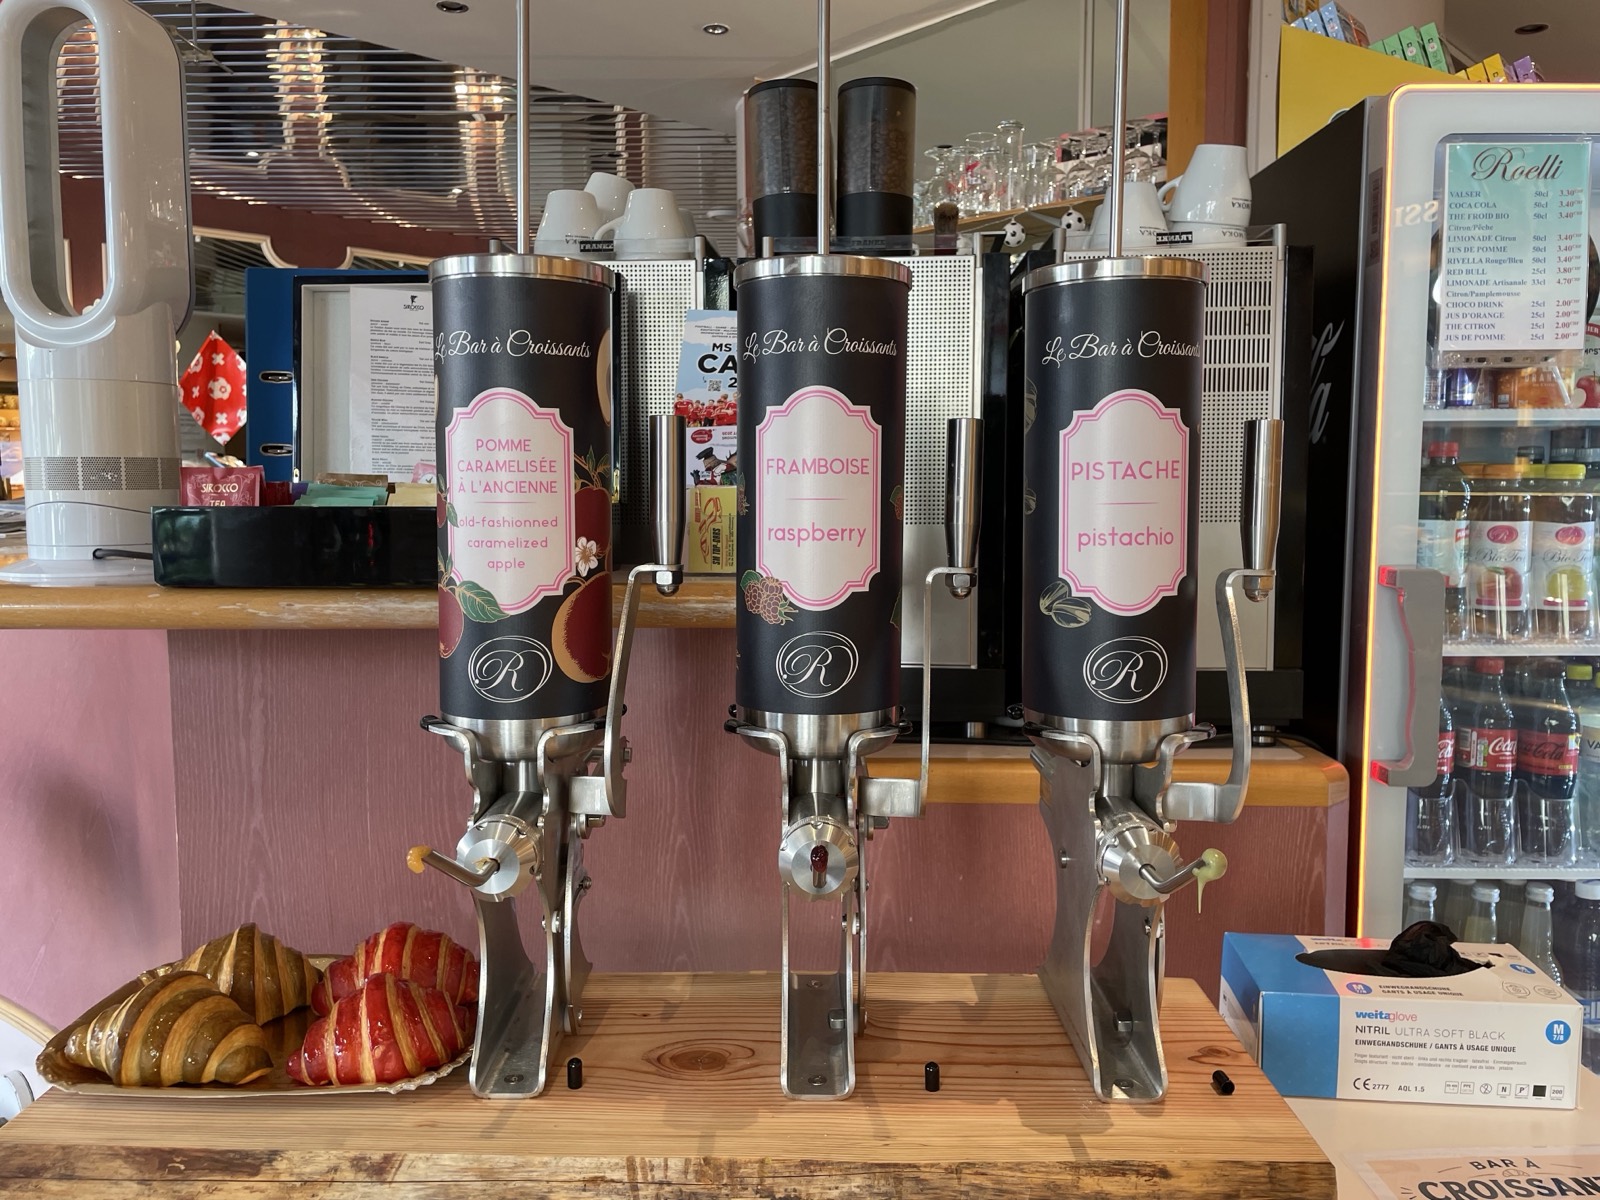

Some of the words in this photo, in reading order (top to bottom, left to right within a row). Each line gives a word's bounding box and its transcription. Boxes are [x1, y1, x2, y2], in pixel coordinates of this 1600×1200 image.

[1471, 147, 1564, 182] Roelli
[435, 332, 448, 364] Le
[448, 330, 488, 356] Bar
[491, 336, 502, 354] à
[507, 329, 591, 358] Croissants
[712, 343, 732, 352] MS
[743, 332, 760, 364] Le
[762, 329, 805, 355] Bar
[808, 335, 820, 352] à
[824, 327, 897, 356] Croissants
[1042, 336, 1066, 368] Le
[1069, 333, 1118, 359] Bar
[1121, 338, 1134, 356] à
[476, 438, 532, 452] POMME
[458, 456, 557, 473] CARAMELISÉE
[766, 458, 870, 476] FRAMBOISE
[1072, 460, 1180, 480] PISTACHE
[201, 483, 238, 492] SIROCCO
[458, 478, 466, 494] À
[471, 480, 558, 494] L'ANCIENNE
[458, 516, 558, 528] old-fashionned
[768, 522, 867, 547] raspberry
[1078, 526, 1174, 552] pistachio
[468, 536, 548, 549] caramelized
[487, 558, 526, 572] apple
[1355, 1026, 1390, 1035] NITRIL
[1395, 1027, 1430, 1037] ULTRA
[1434, 1028, 1464, 1038] SOFT
[1468, 1030, 1506, 1040] BLACK
[1554, 1024, 1564, 1034] M
[1355, 1039, 1427, 1049] EINWEGHANDSCHUHE
[1460, 1042, 1464, 1050] À
[1469, 1158, 1516, 1170] BAR
[1524, 1158, 1542, 1169] À
